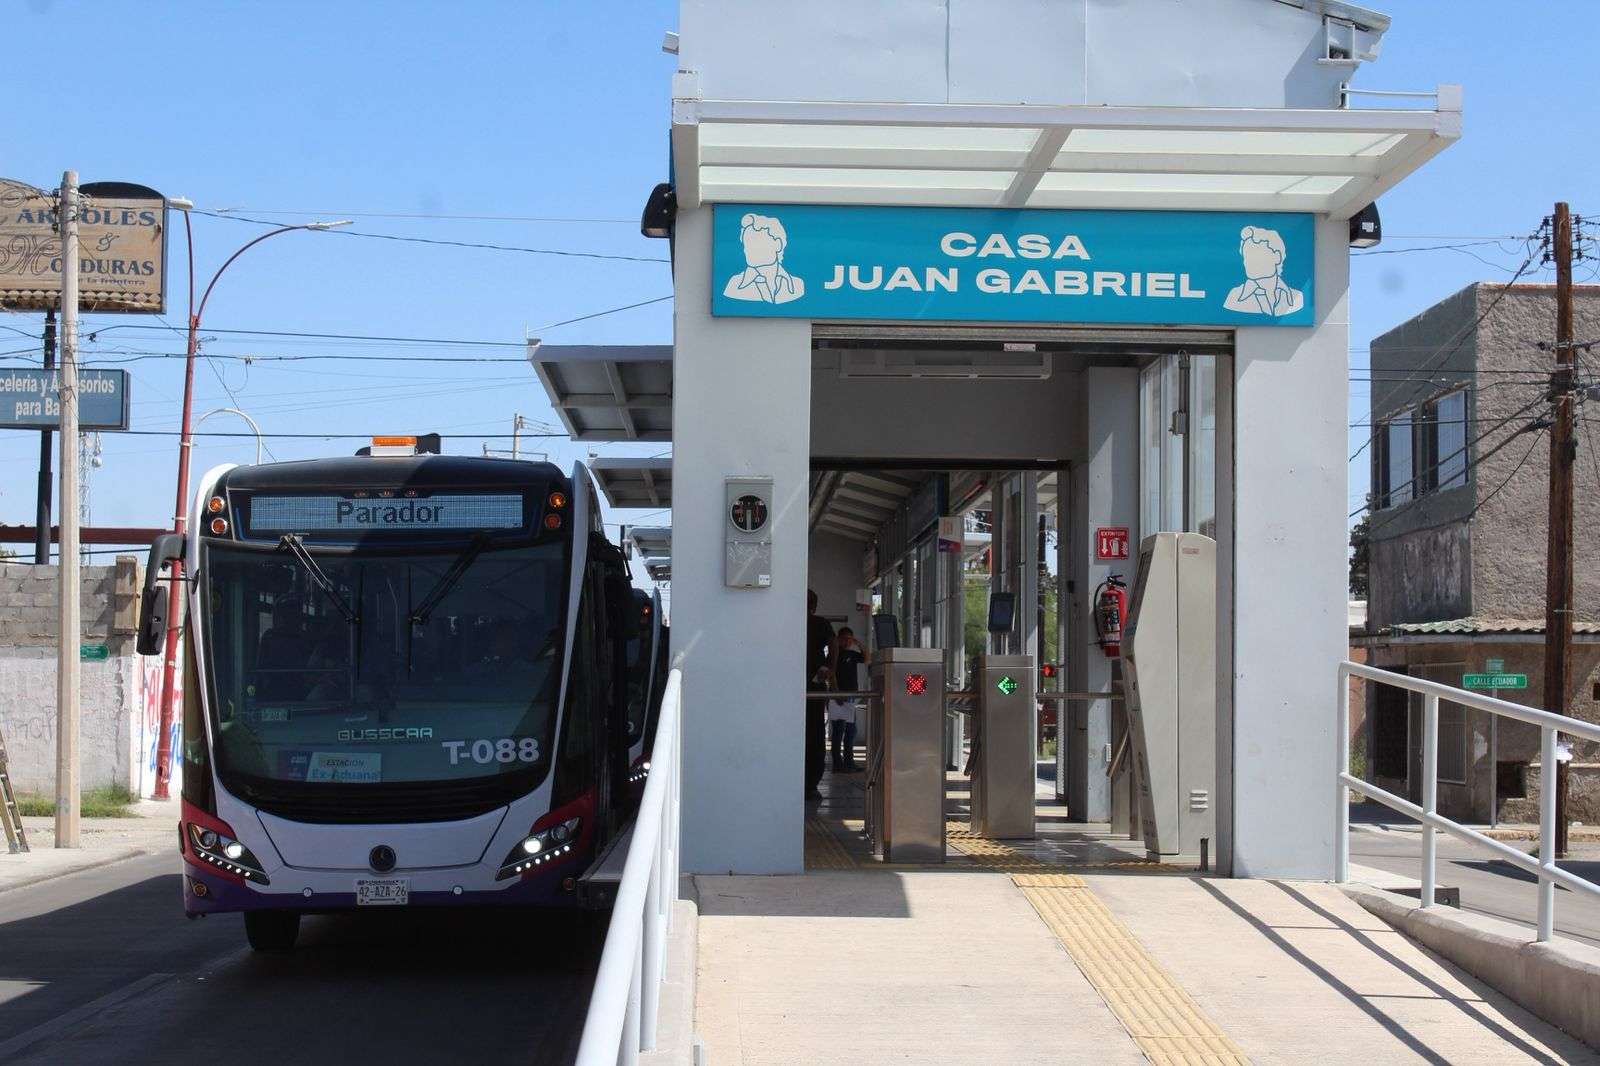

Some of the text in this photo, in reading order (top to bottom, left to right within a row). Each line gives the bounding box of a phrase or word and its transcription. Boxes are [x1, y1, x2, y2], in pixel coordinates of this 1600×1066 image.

[16, 208, 156, 226] AROLES
[940, 232, 1090, 260] CASA
[824, 265, 1206, 298] JUAN GABRIEL
[41, 379, 48, 397] y
[16, 401, 41, 420] para
[336, 500, 444, 523] Parador
[1473, 677, 1517, 686] CALLE ECUADOR
[337, 728, 433, 741] BUSSCAR
[441, 738, 540, 765] T-088
